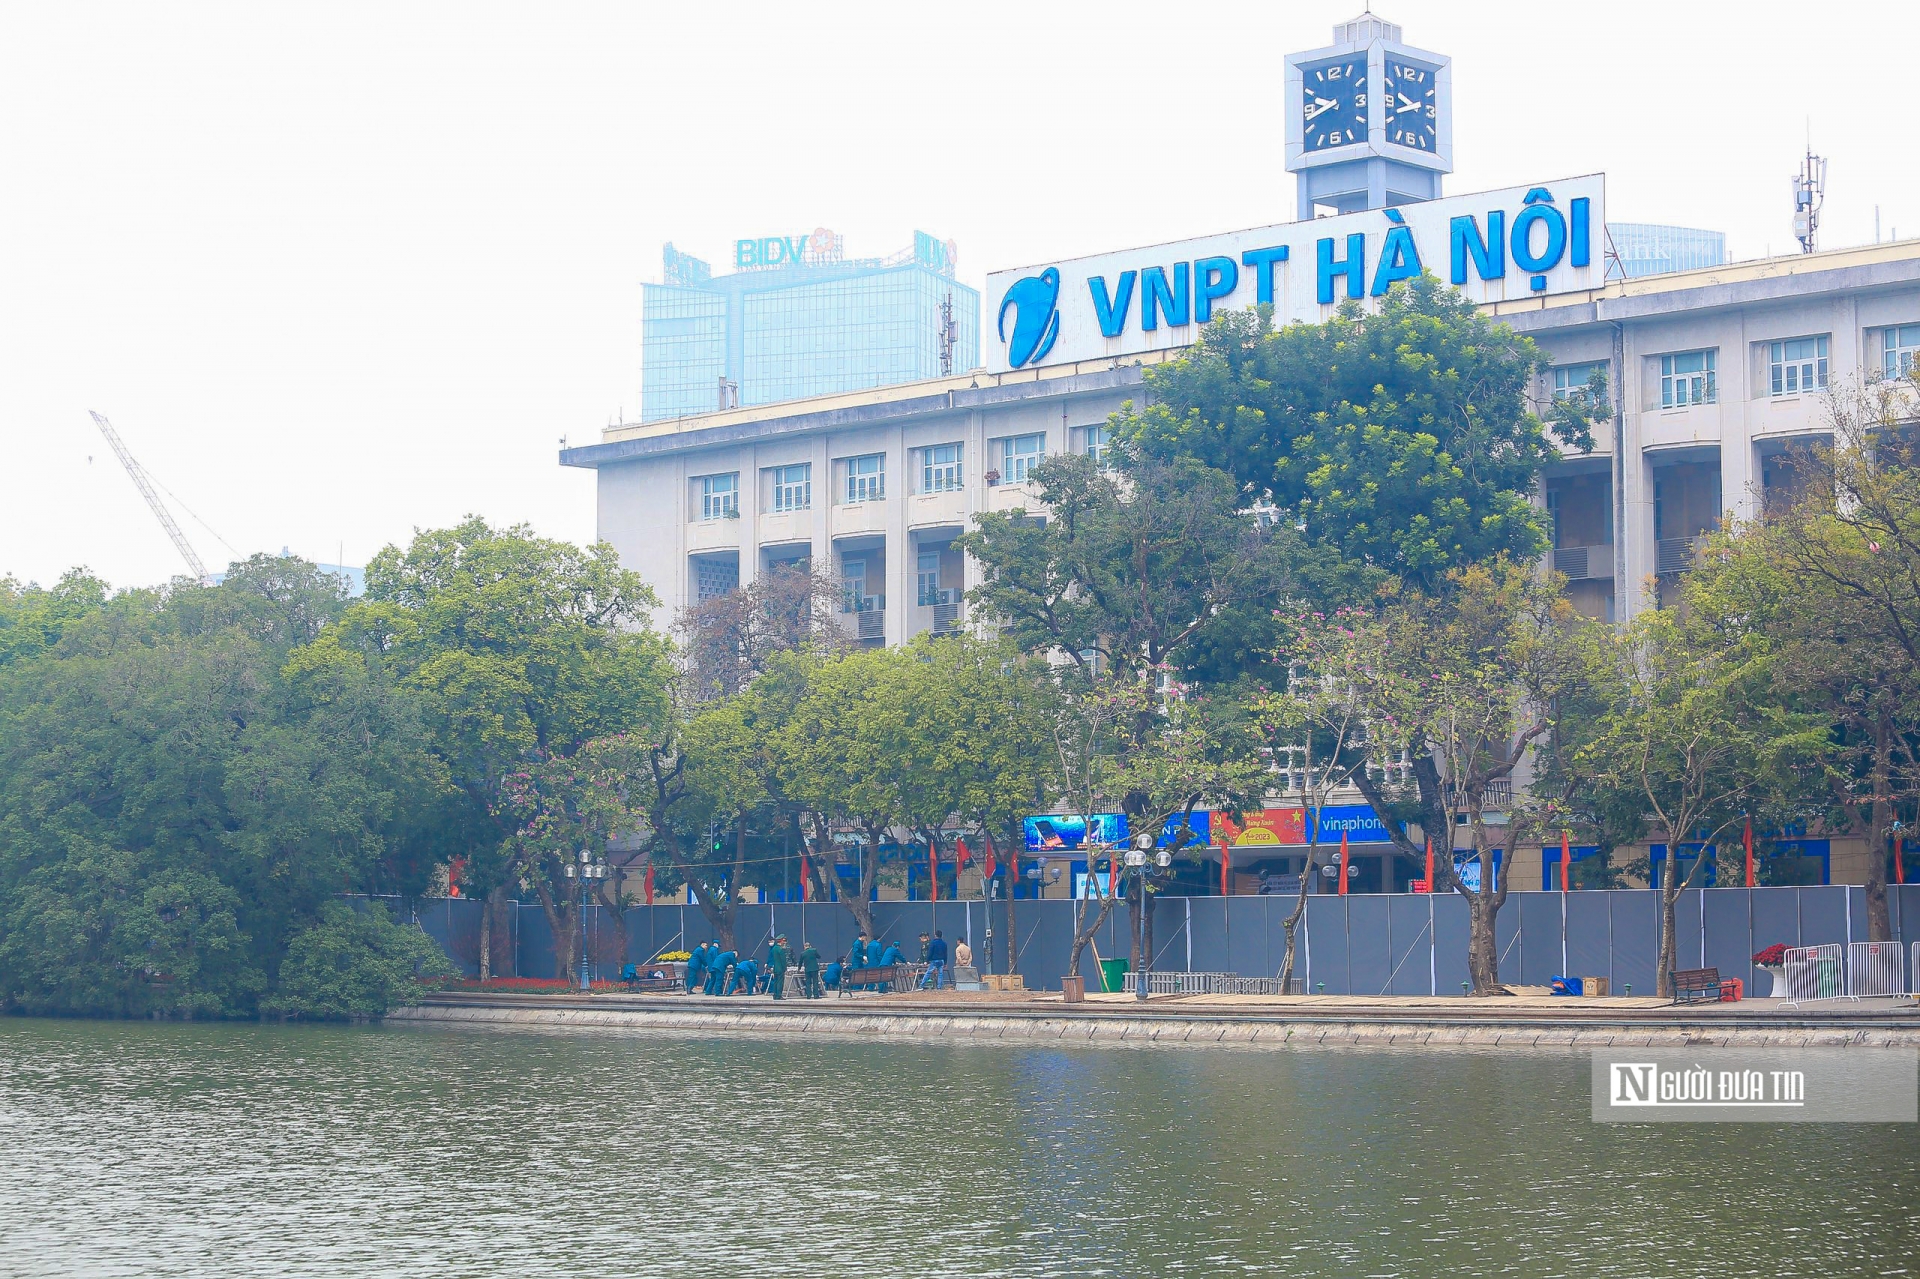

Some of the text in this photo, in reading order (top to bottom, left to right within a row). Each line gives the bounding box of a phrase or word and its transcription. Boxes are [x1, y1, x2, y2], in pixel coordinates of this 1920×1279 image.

[1328, 66, 1342, 80] 12
[1403, 67, 1416, 80] 12
[1355, 93, 1367, 108] 3
[1385, 94, 1395, 108] 9
[1425, 105, 1436, 119] 3
[1330, 131, 1342, 145] 6
[1405, 131, 1416, 145] 6
[736, 236, 810, 266] BIDV
[1087, 186, 1592, 338] VNPT HÀ NỘI
[1322, 815, 1385, 832] vinaphon
[1255, 833, 1271, 841] 2023
[1807, 951, 1817, 959] STOP
